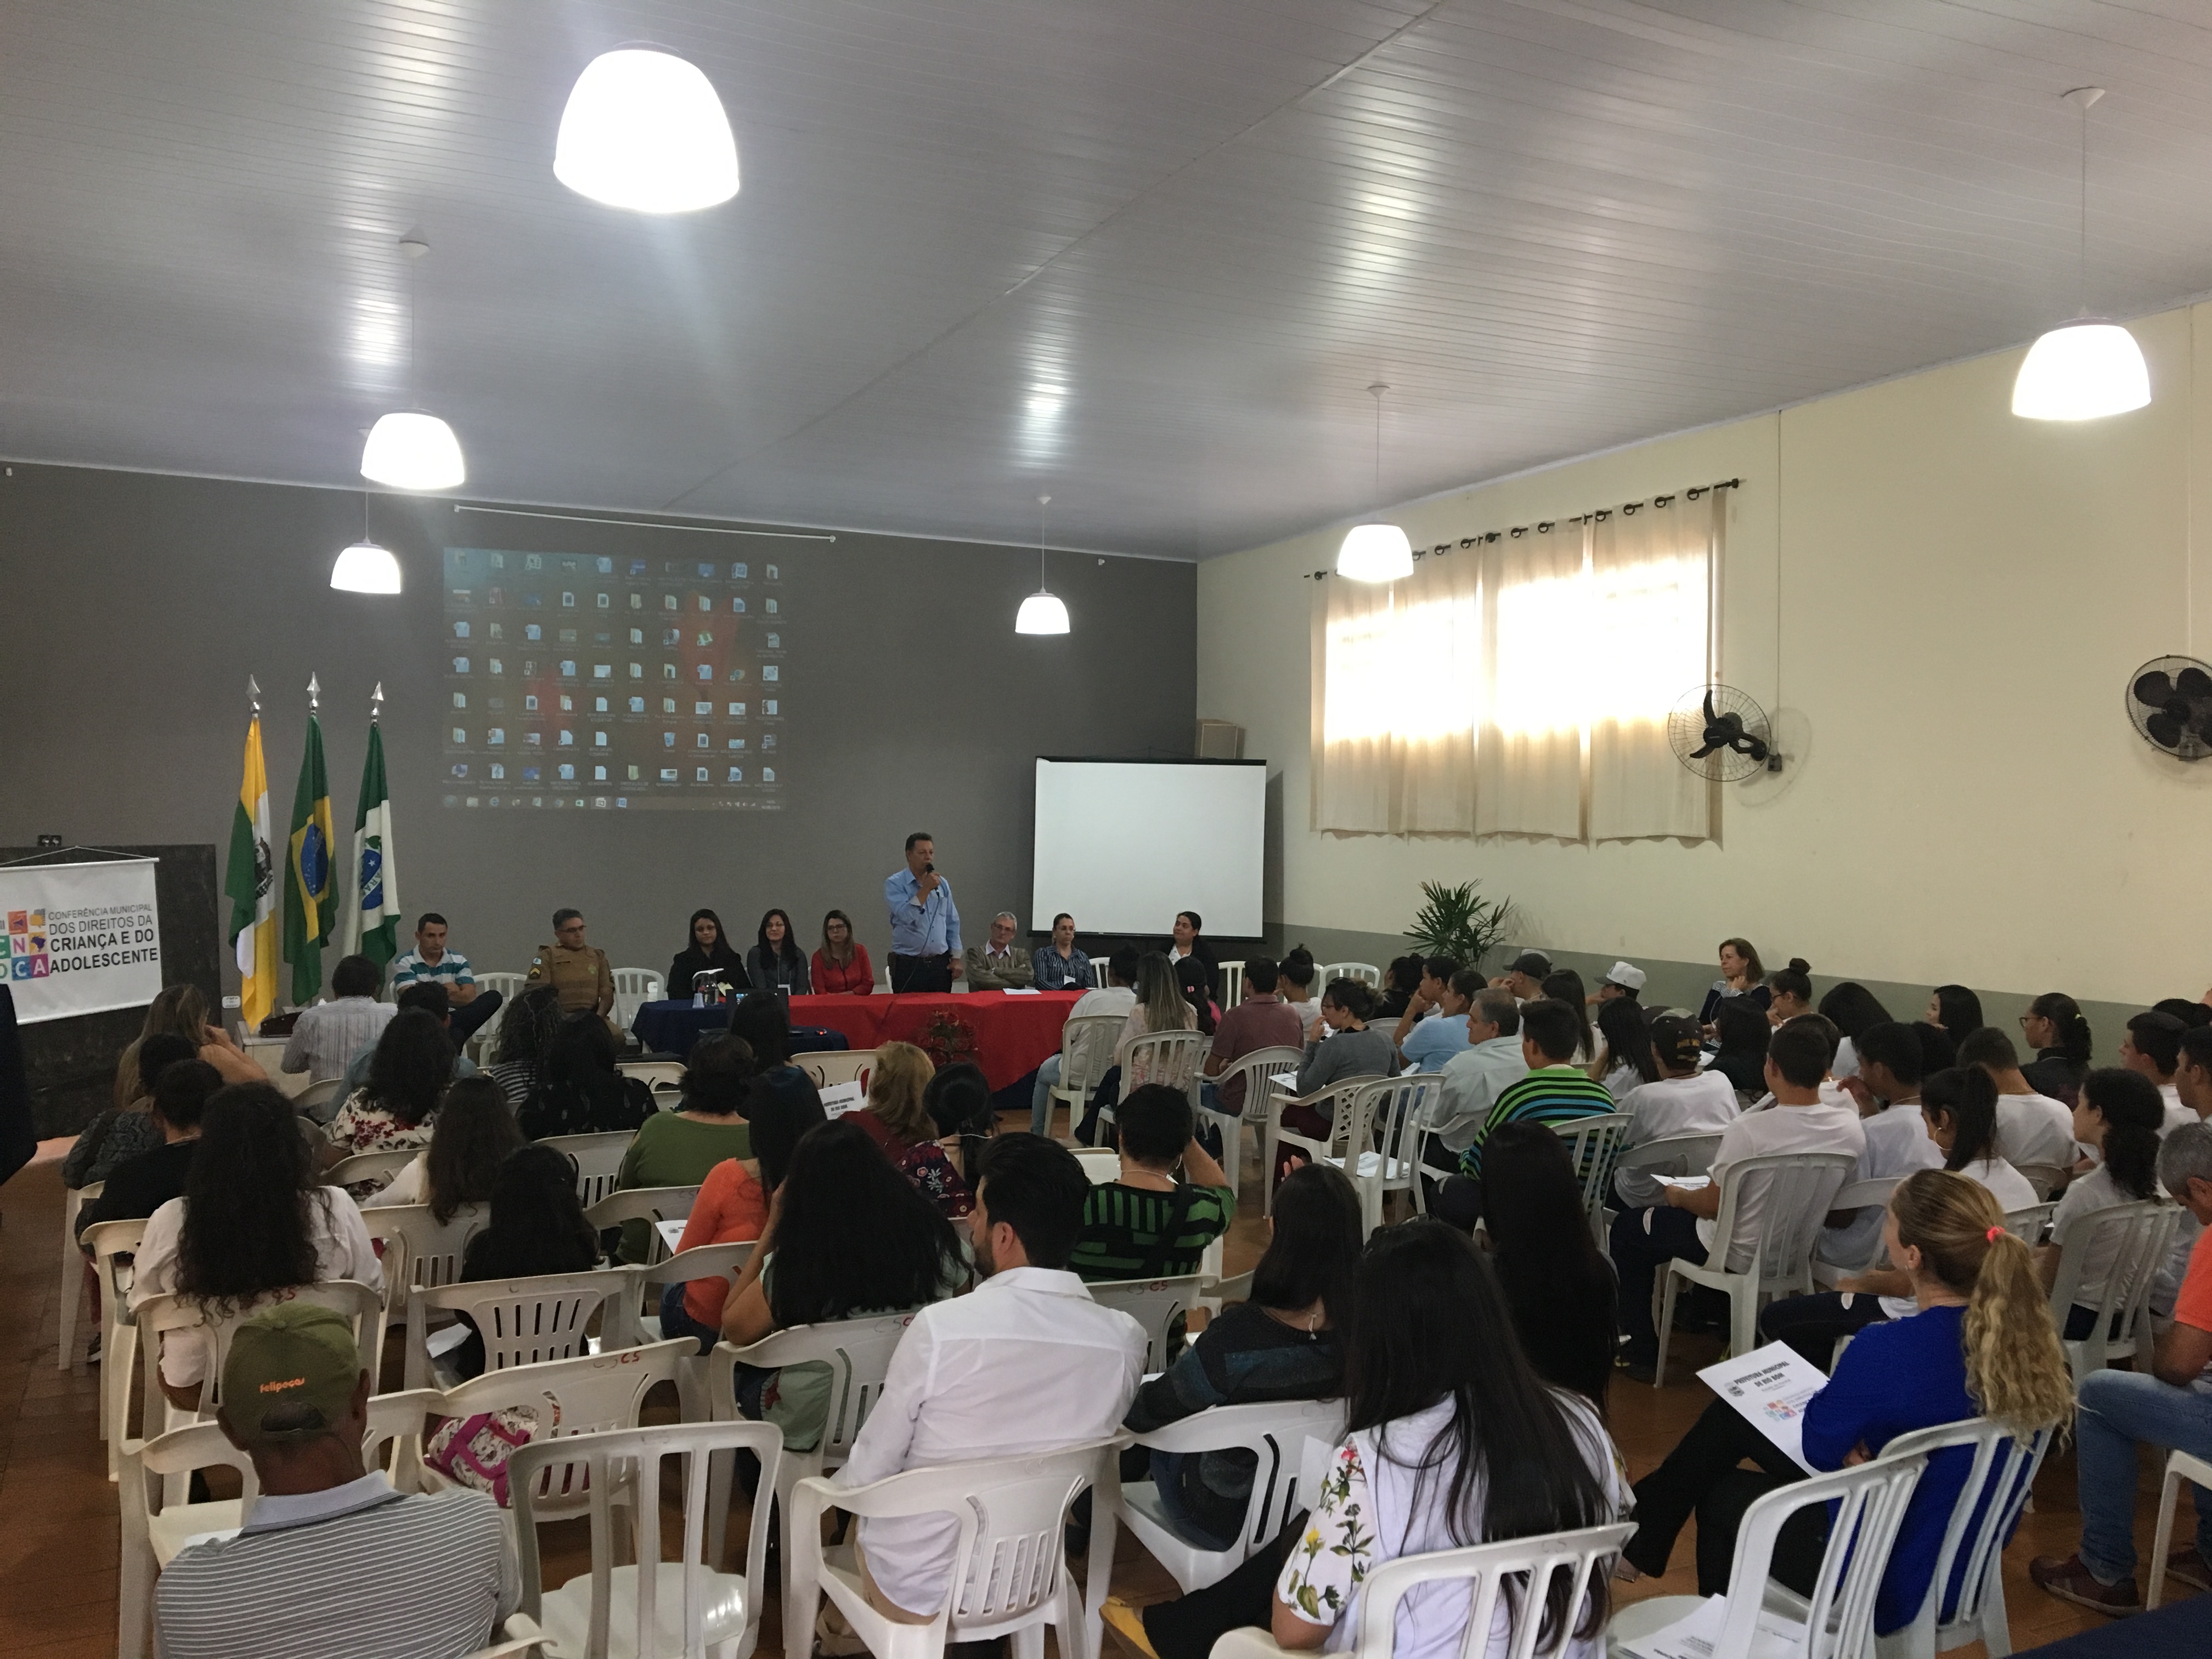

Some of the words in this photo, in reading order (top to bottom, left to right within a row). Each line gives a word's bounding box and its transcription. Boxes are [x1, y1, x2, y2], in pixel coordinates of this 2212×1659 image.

[48, 907, 109, 920] CONFERÊNCIA
[110, 904, 153, 915] MUNICIPAL
[49, 922, 76, 935] DOS
[78, 916, 134, 932] DIREITOS
[137, 914, 153, 927] DA
[50, 933, 117, 952] CRIANÇA
[121, 931, 131, 945] E
[134, 928, 154, 943] DO
[50, 947, 158, 974] ADOLESCENTE
[1734, 1372, 1762, 1384] PREFEITURA
[1762, 1361, 1790, 1374] MUNICIPAL
